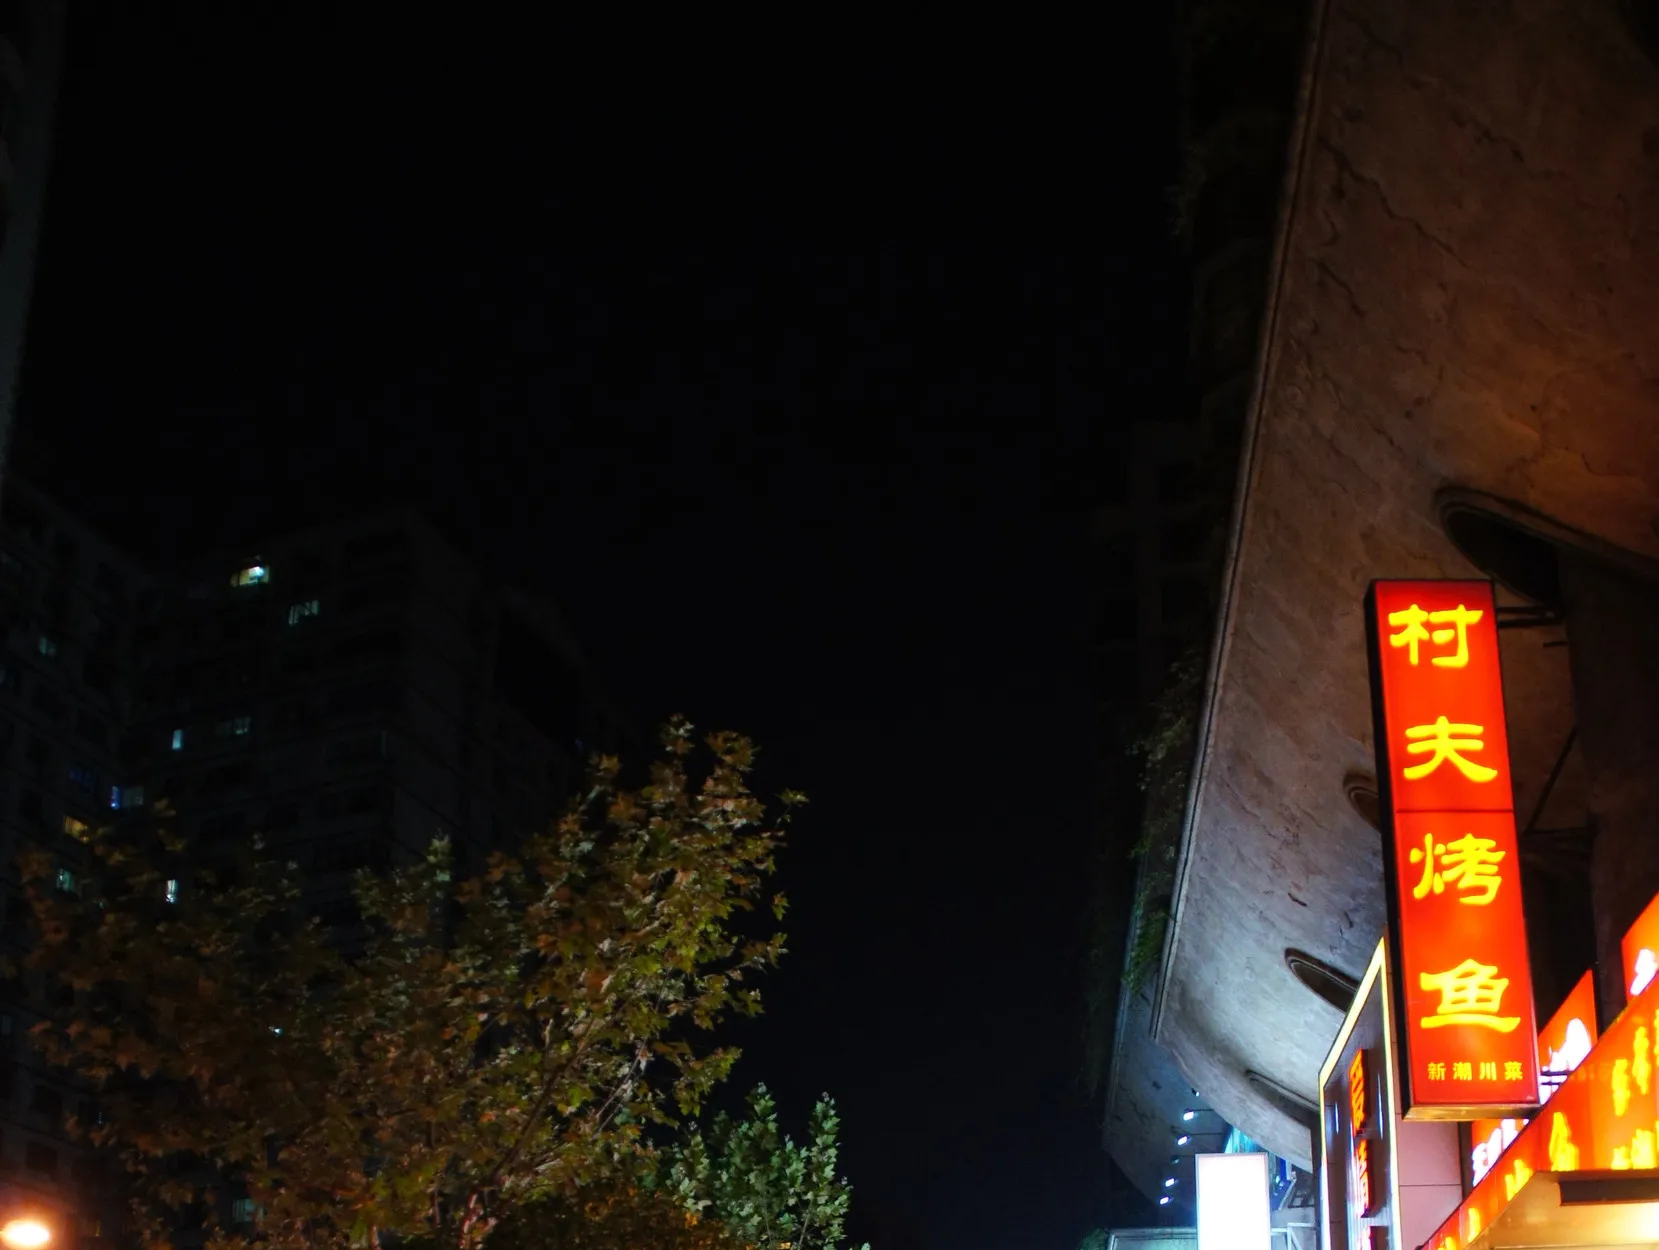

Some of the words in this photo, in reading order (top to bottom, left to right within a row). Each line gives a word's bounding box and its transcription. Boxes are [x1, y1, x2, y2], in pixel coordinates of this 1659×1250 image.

[1388, 604, 1521, 1032] 村夫烤鱼
[1427, 1061, 1523, 1081] 新潮川菜
